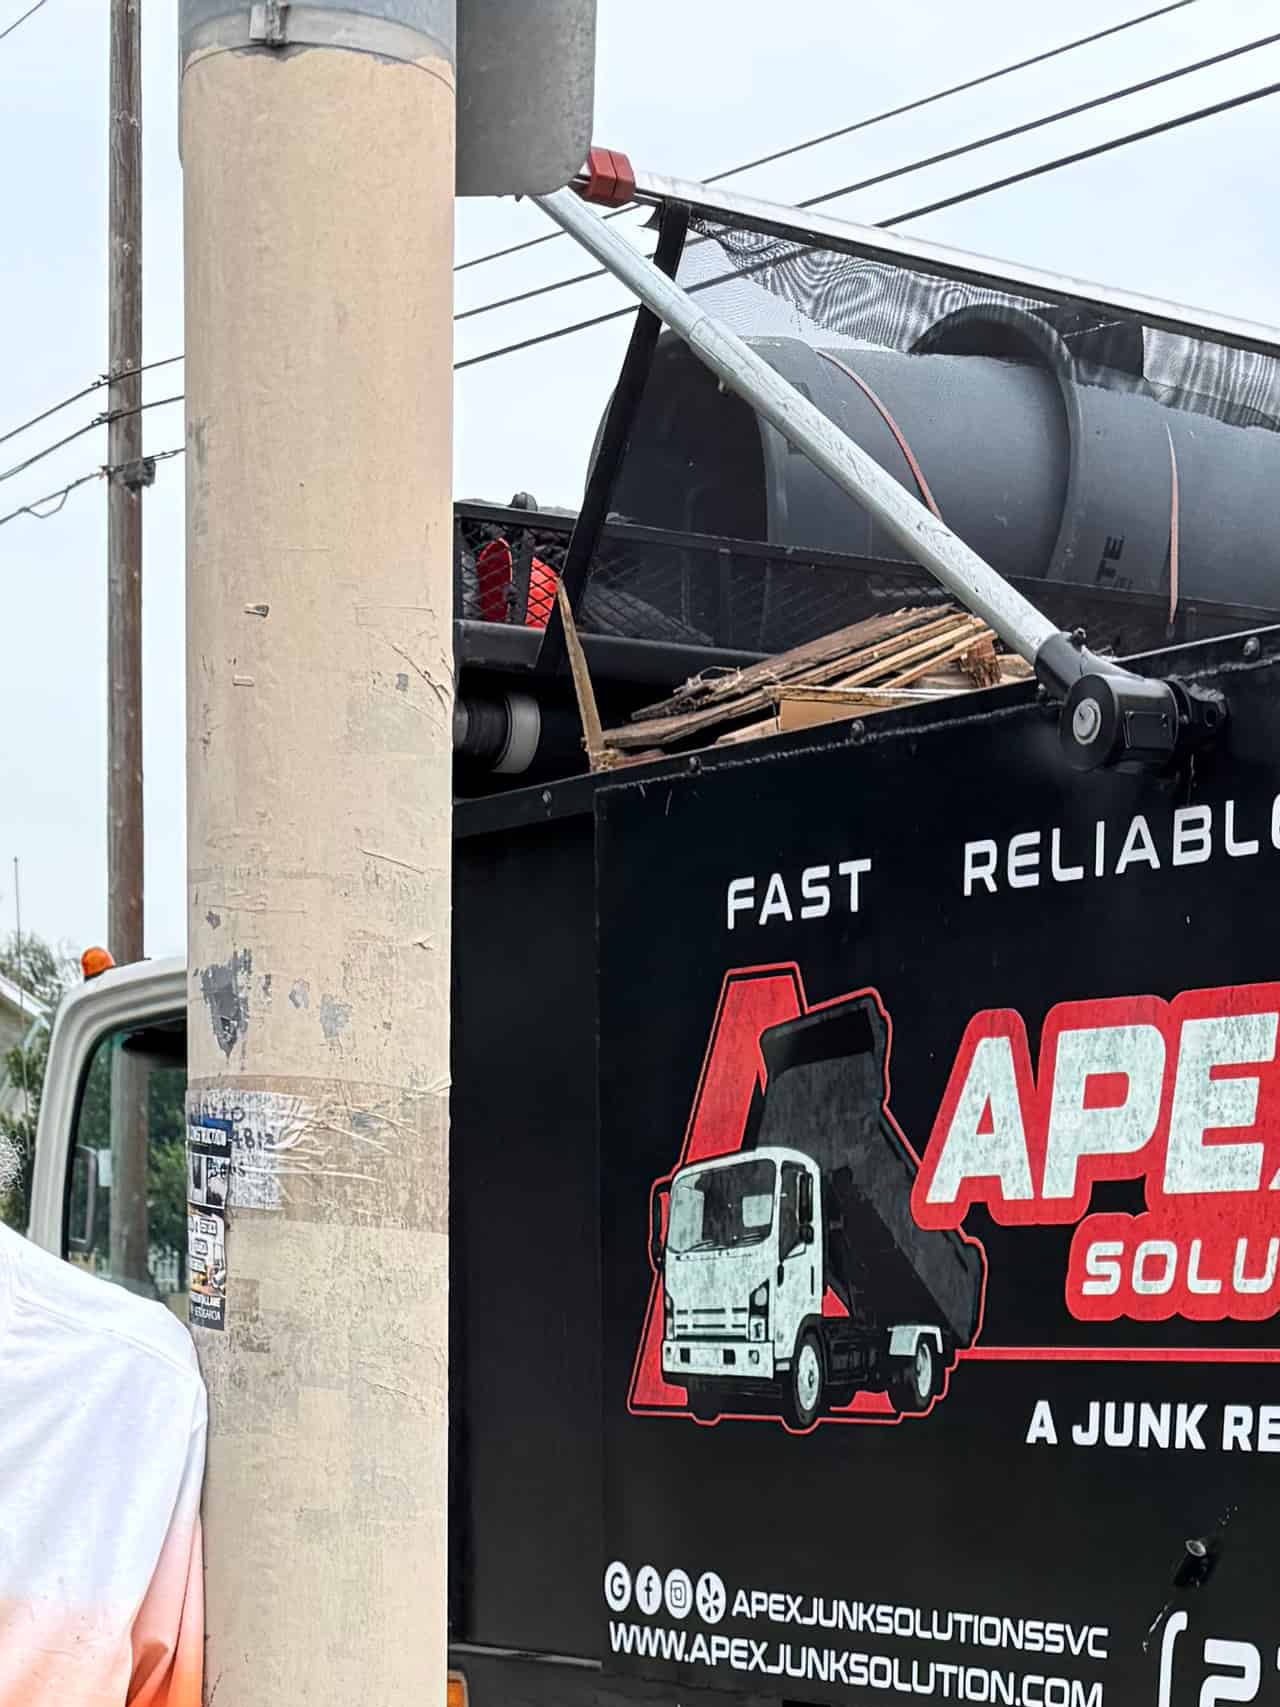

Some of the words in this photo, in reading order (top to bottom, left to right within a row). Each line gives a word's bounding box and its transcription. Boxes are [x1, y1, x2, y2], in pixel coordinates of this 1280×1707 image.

[726, 858, 872, 930] FAST
[1025, 1399, 1058, 1445] A
[1071, 1401, 1206, 1450] JUNK
[730, 1589, 1109, 1659] APEXJUNKSOLUTIONSSVC
